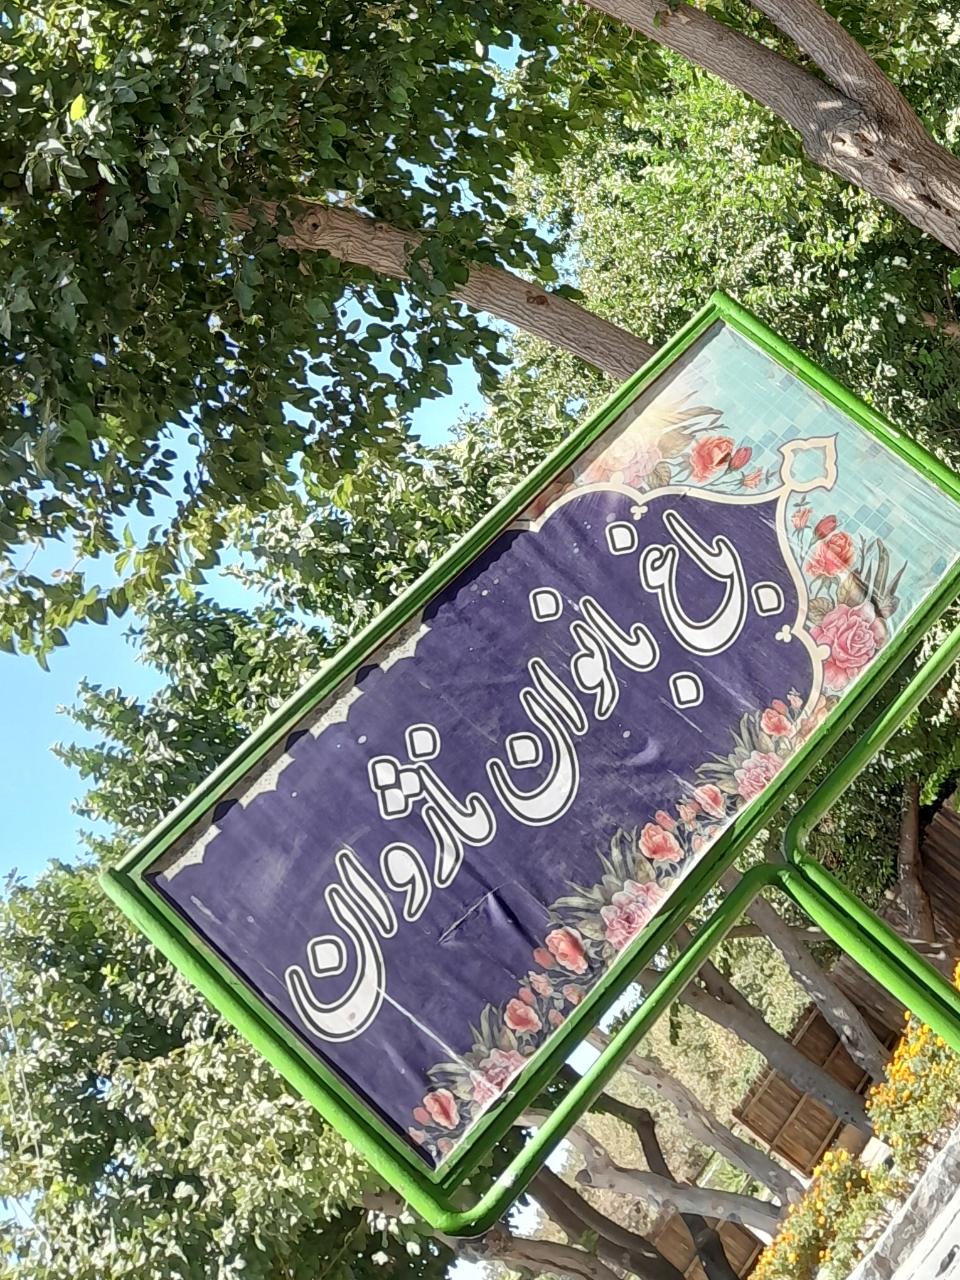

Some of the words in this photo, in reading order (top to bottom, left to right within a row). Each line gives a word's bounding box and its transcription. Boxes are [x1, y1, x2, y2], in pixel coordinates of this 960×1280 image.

[606, 509, 784, 656] باغ
[487, 588, 702, 826] بانوان
[286, 725, 496, 1043] ناژوان
